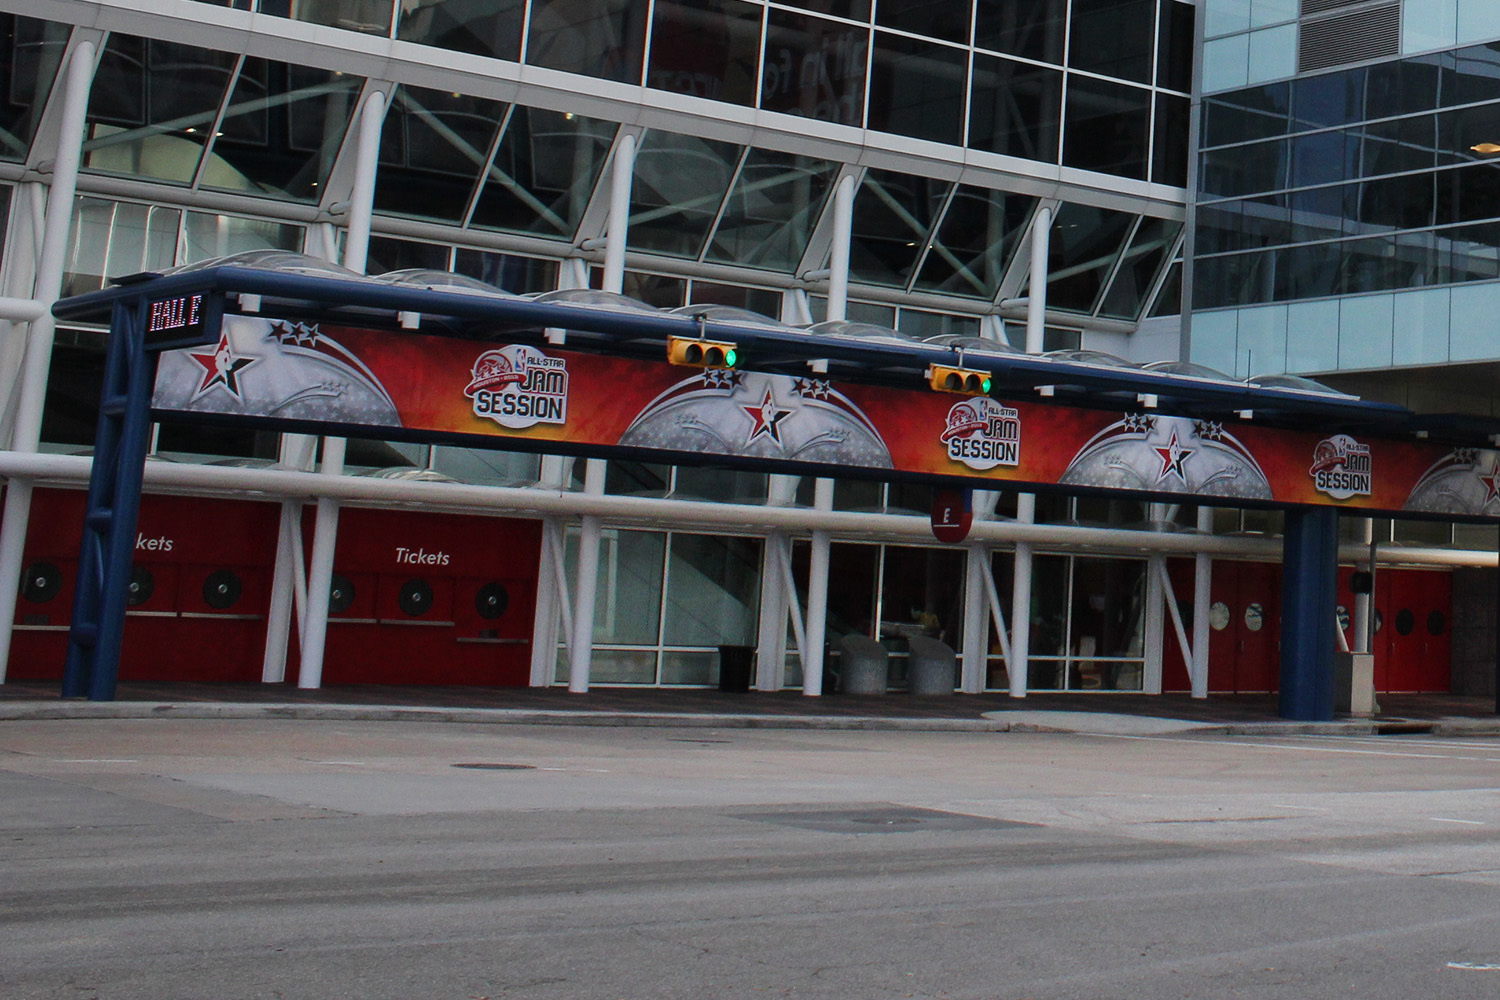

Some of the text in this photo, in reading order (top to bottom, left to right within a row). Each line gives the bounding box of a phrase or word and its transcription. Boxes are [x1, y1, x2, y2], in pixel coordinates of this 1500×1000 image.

[149, 295, 202, 331] HALL E
[527, 357, 564, 367] ALL-STAR
[520, 369, 564, 394] JAM
[477, 391, 563, 419] SESSION
[982, 419, 1017, 439] JAM
[951, 438, 1016, 461] SESSION
[1342, 454, 1369, 472] JAM
[1317, 472, 1369, 491] SESSION
[136, 533, 174, 551] kets
[395, 548, 450, 565] Tickets
